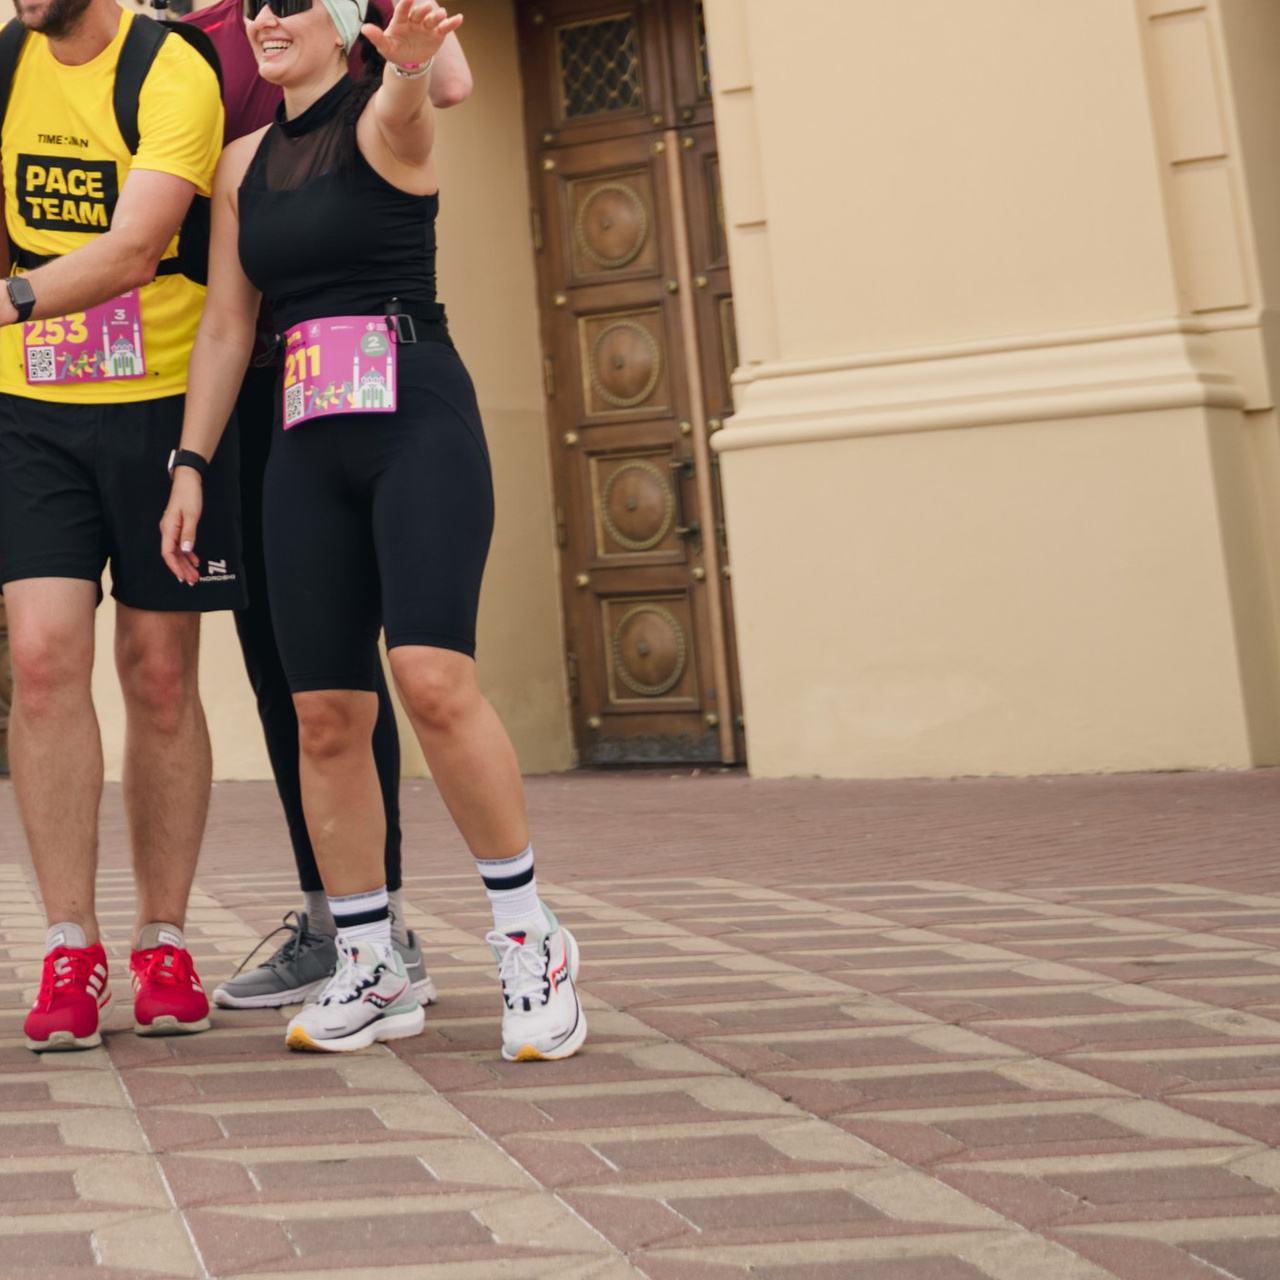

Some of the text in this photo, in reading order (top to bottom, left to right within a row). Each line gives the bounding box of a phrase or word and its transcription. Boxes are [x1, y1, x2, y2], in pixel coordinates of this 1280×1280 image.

[26, 165, 105, 199] PACE
[25, 196, 109, 227] TEAM
[25, 312, 89, 346] 253
[114, 309, 126, 320] 3
[367, 336, 381, 348] 2
[285, 344, 320, 389] 211
